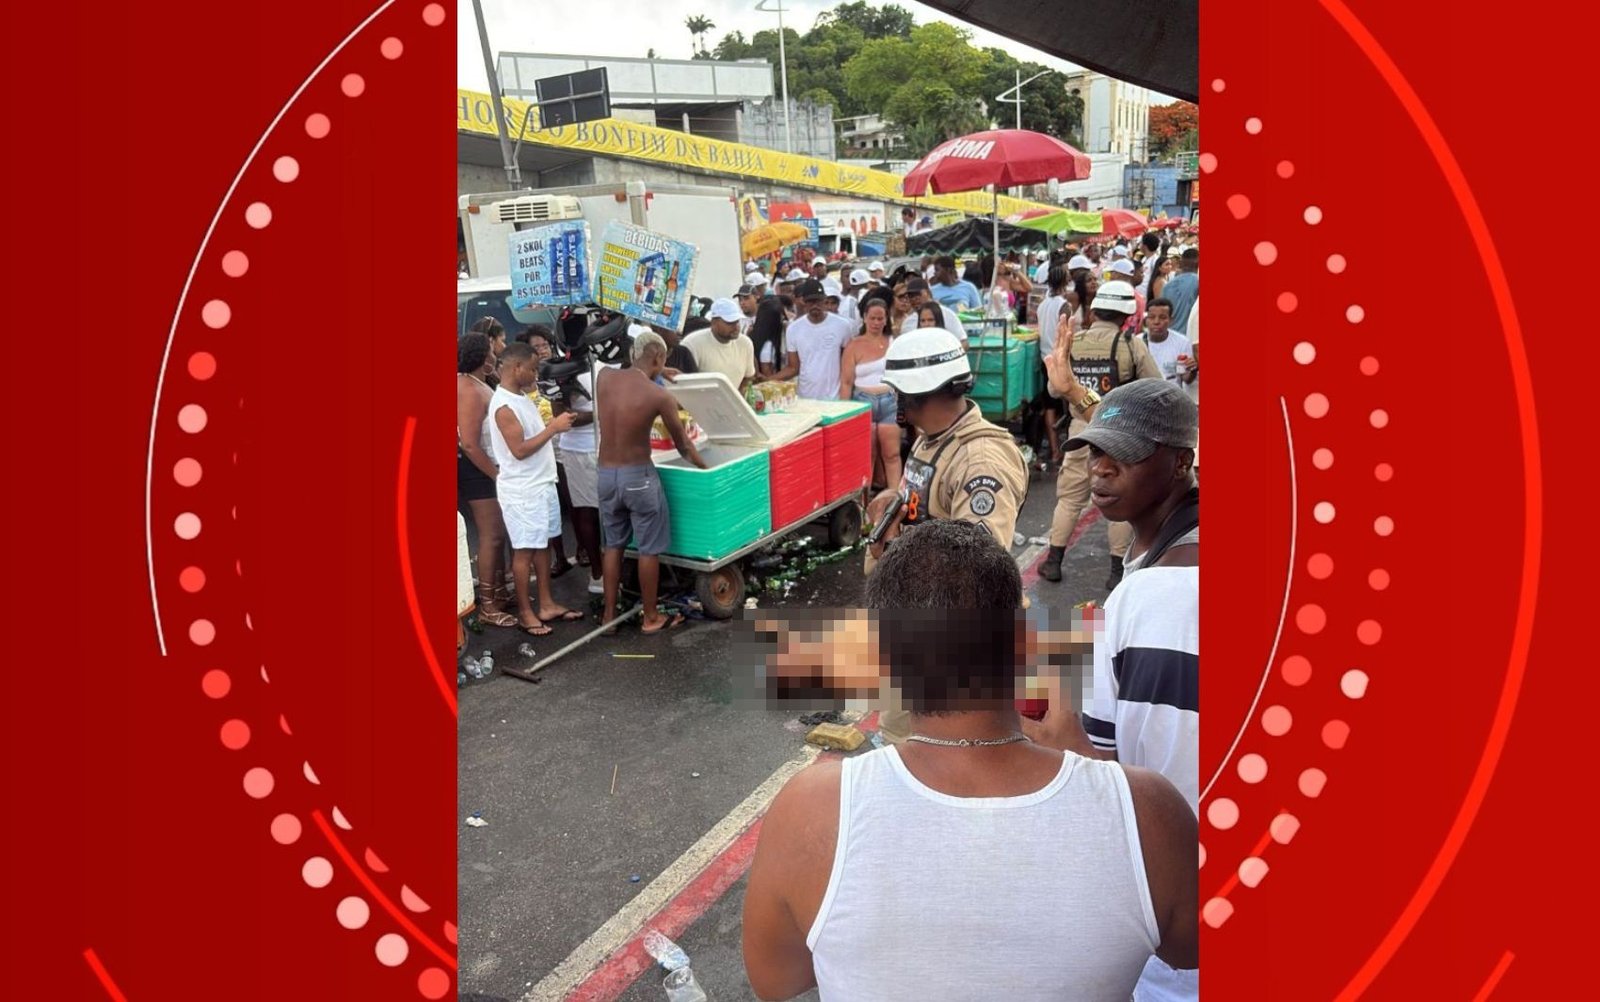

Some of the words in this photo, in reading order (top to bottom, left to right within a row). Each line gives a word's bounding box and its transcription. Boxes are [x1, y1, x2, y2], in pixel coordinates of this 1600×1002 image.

[576, 121, 666, 153] BONFIM
[676, 138, 700, 161] DA
[708, 144, 765, 171] BAHIA
[517, 244, 522, 254] 2
[524, 240, 544, 253] SKOL
[625, 230, 671, 255] BEBIDAS
[520, 255, 544, 269] BEATS
[556, 241, 564, 284] BEATS
[568, 233, 577, 276] BEATS
[524, 271, 541, 283] POR
[1091, 366, 1111, 374] MILITAR
[1101, 375, 1111, 392] C
